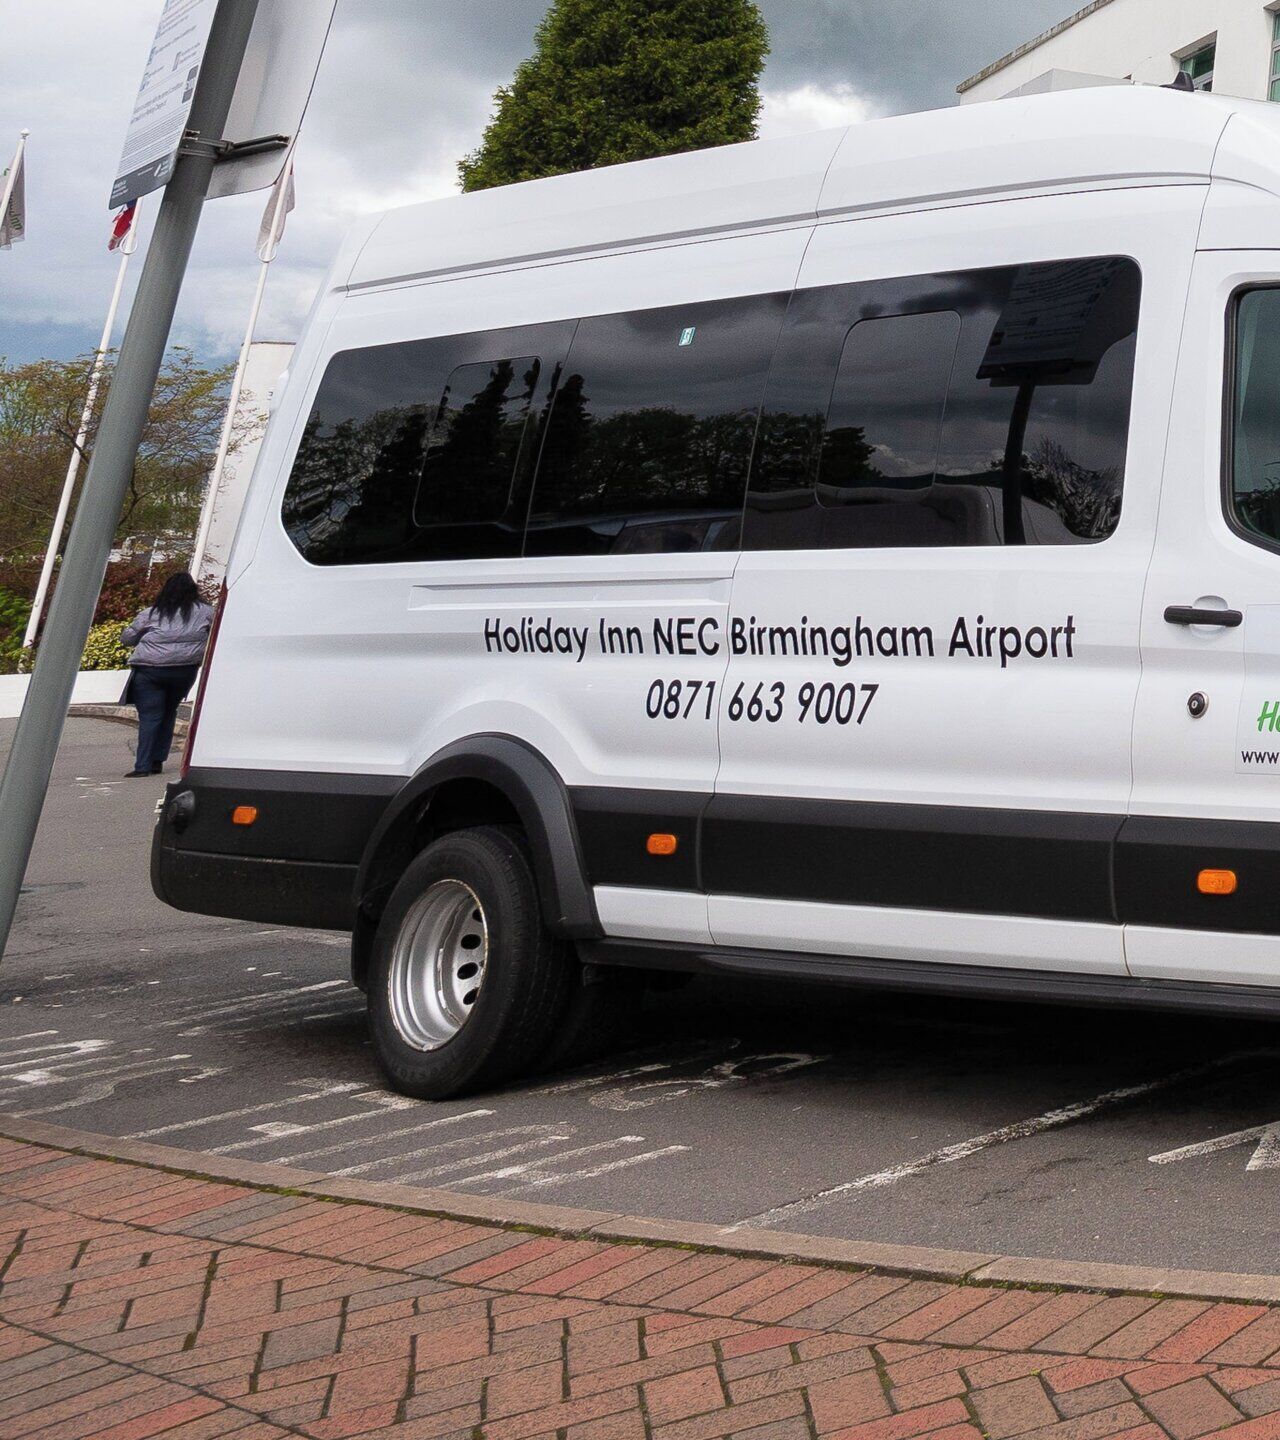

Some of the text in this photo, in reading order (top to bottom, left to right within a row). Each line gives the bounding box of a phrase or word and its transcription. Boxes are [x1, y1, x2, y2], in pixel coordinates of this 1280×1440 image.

[484, 615, 1076, 668] Holiday Inn NEC Birmingham Airport
[646, 678, 879, 724] 0871 663 9007
